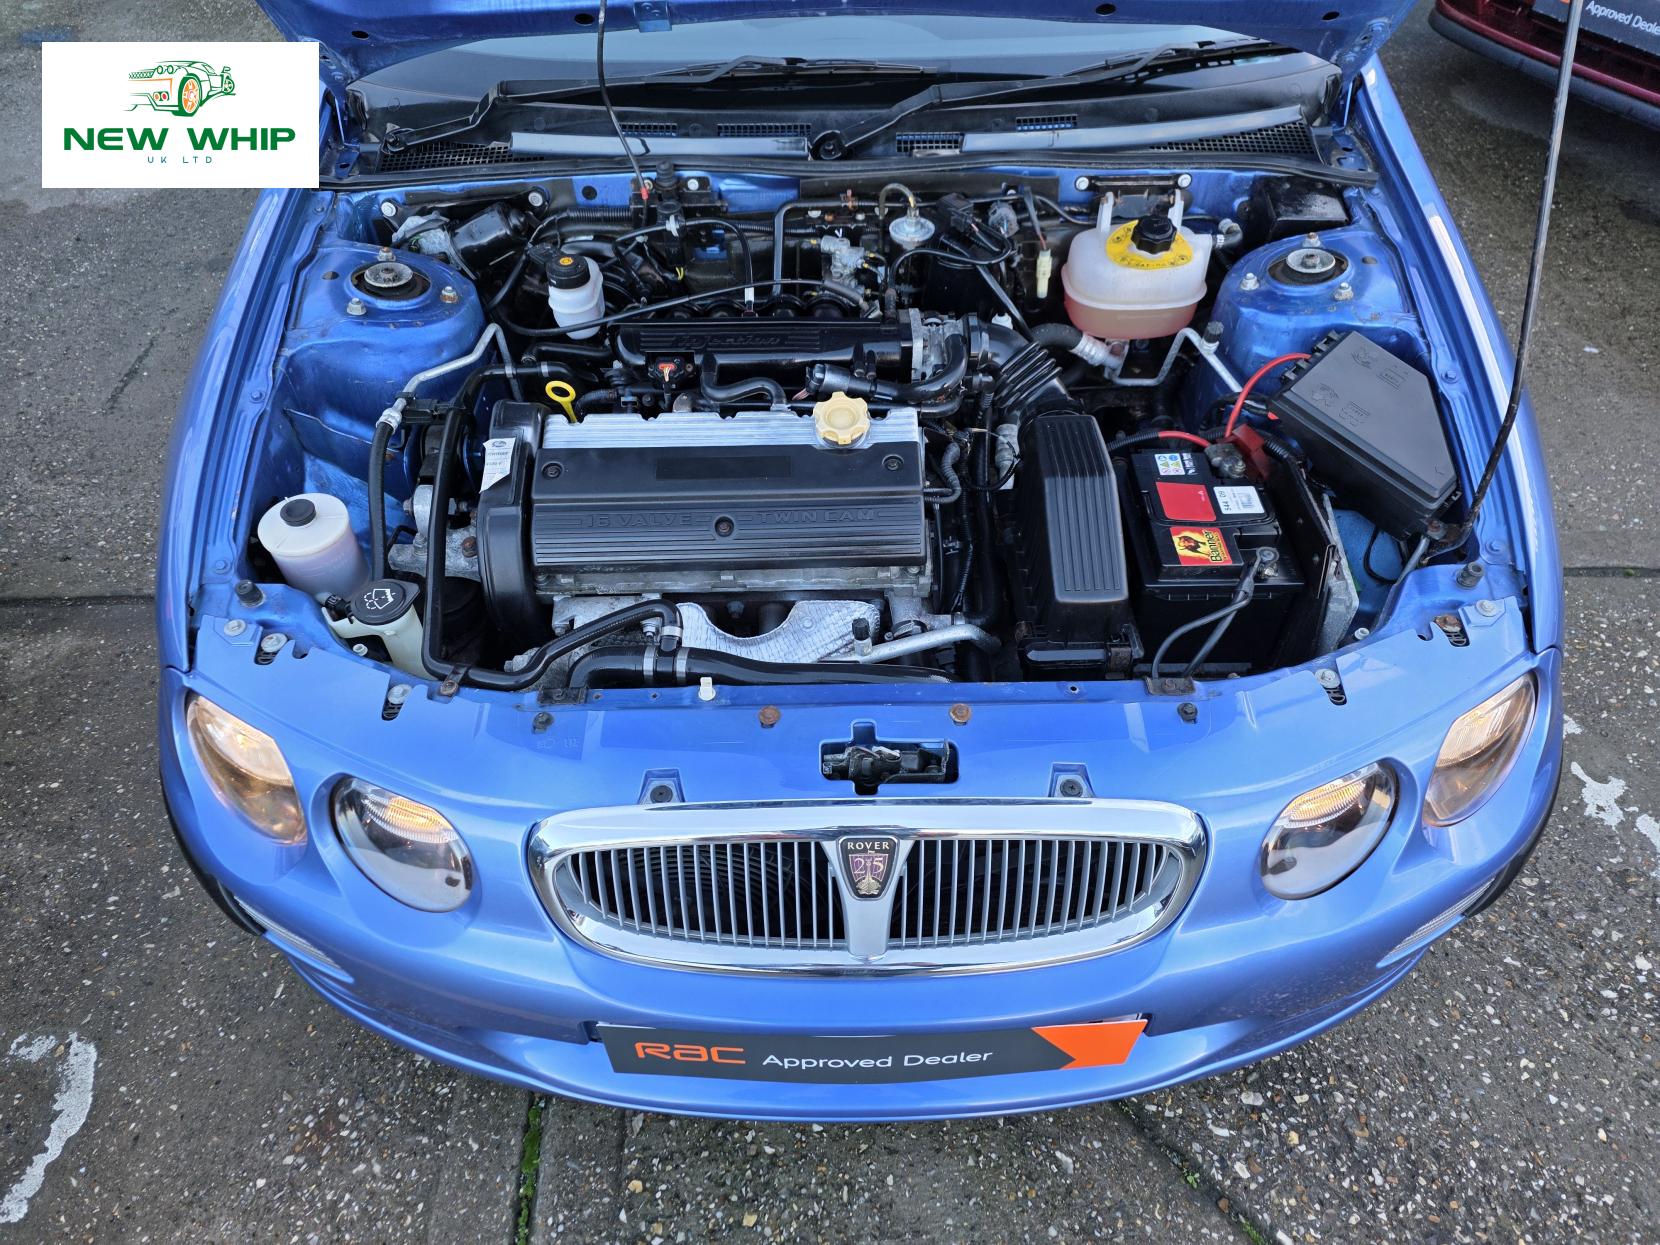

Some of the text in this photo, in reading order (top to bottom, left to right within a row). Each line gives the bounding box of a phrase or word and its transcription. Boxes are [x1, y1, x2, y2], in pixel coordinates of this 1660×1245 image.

[1585, 0, 1660, 36] Approved Deale
[617, 513, 692, 527] VALVE
[758, 507, 875, 524] TWIN CAM
[1202, 529, 1224, 562] Banner
[847, 841, 890, 850] ROVER
[853, 857, 885, 874] 25
[762, 1054, 893, 1070] Approved
[903, 1052, 994, 1067] Dealer
